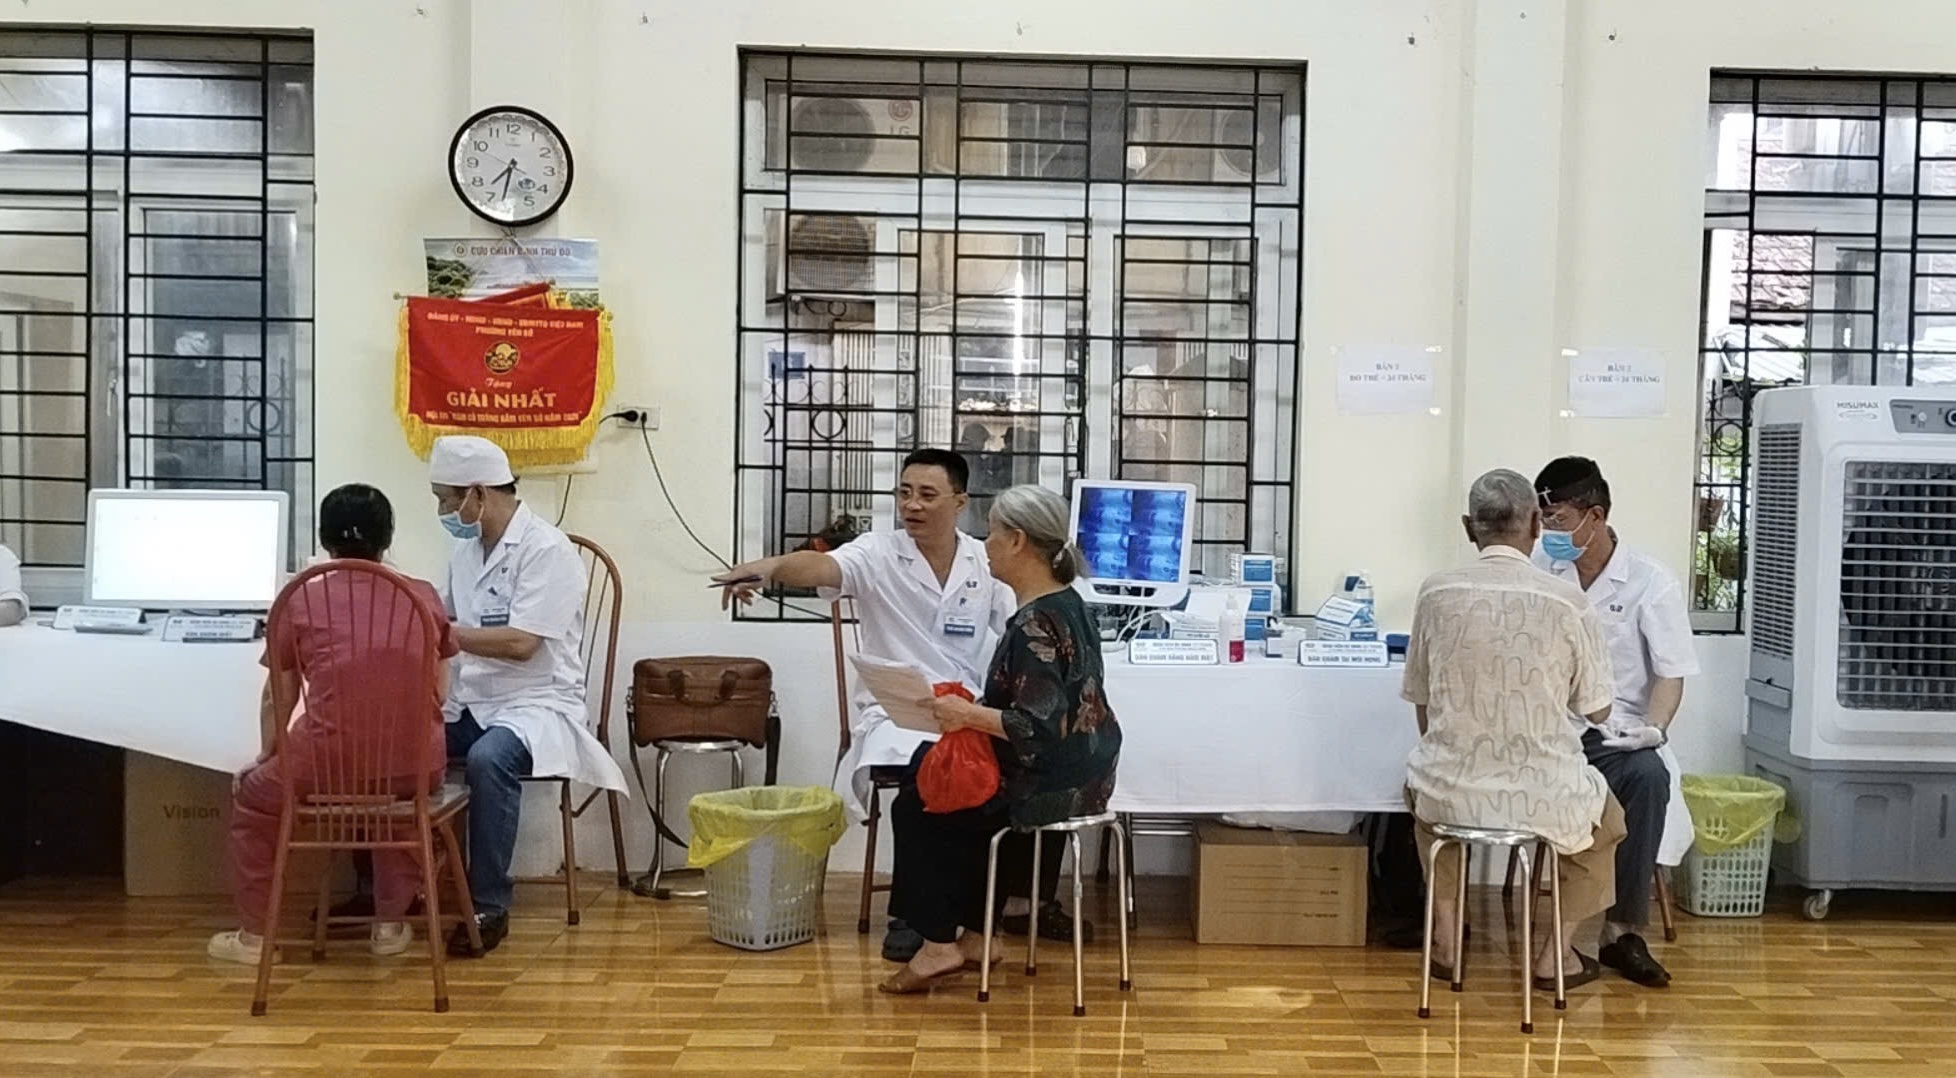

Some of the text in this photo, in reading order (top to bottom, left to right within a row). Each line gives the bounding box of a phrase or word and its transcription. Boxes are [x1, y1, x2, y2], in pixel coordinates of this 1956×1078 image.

[489, 127, 499, 138] 11
[506, 124, 521, 135] 12
[473, 140, 488, 152] 10
[539, 147, 551, 158] 2
[466, 157, 479, 168] 9
[543, 166, 555, 177] 3
[472, 176, 484, 187] 8
[537, 184, 548, 194] 4
[485, 192, 495, 202] 7
[524, 195, 535, 206] 5
[446, 386, 557, 408] GIẢI NHẤT
[163, 804, 220, 819] Vision
